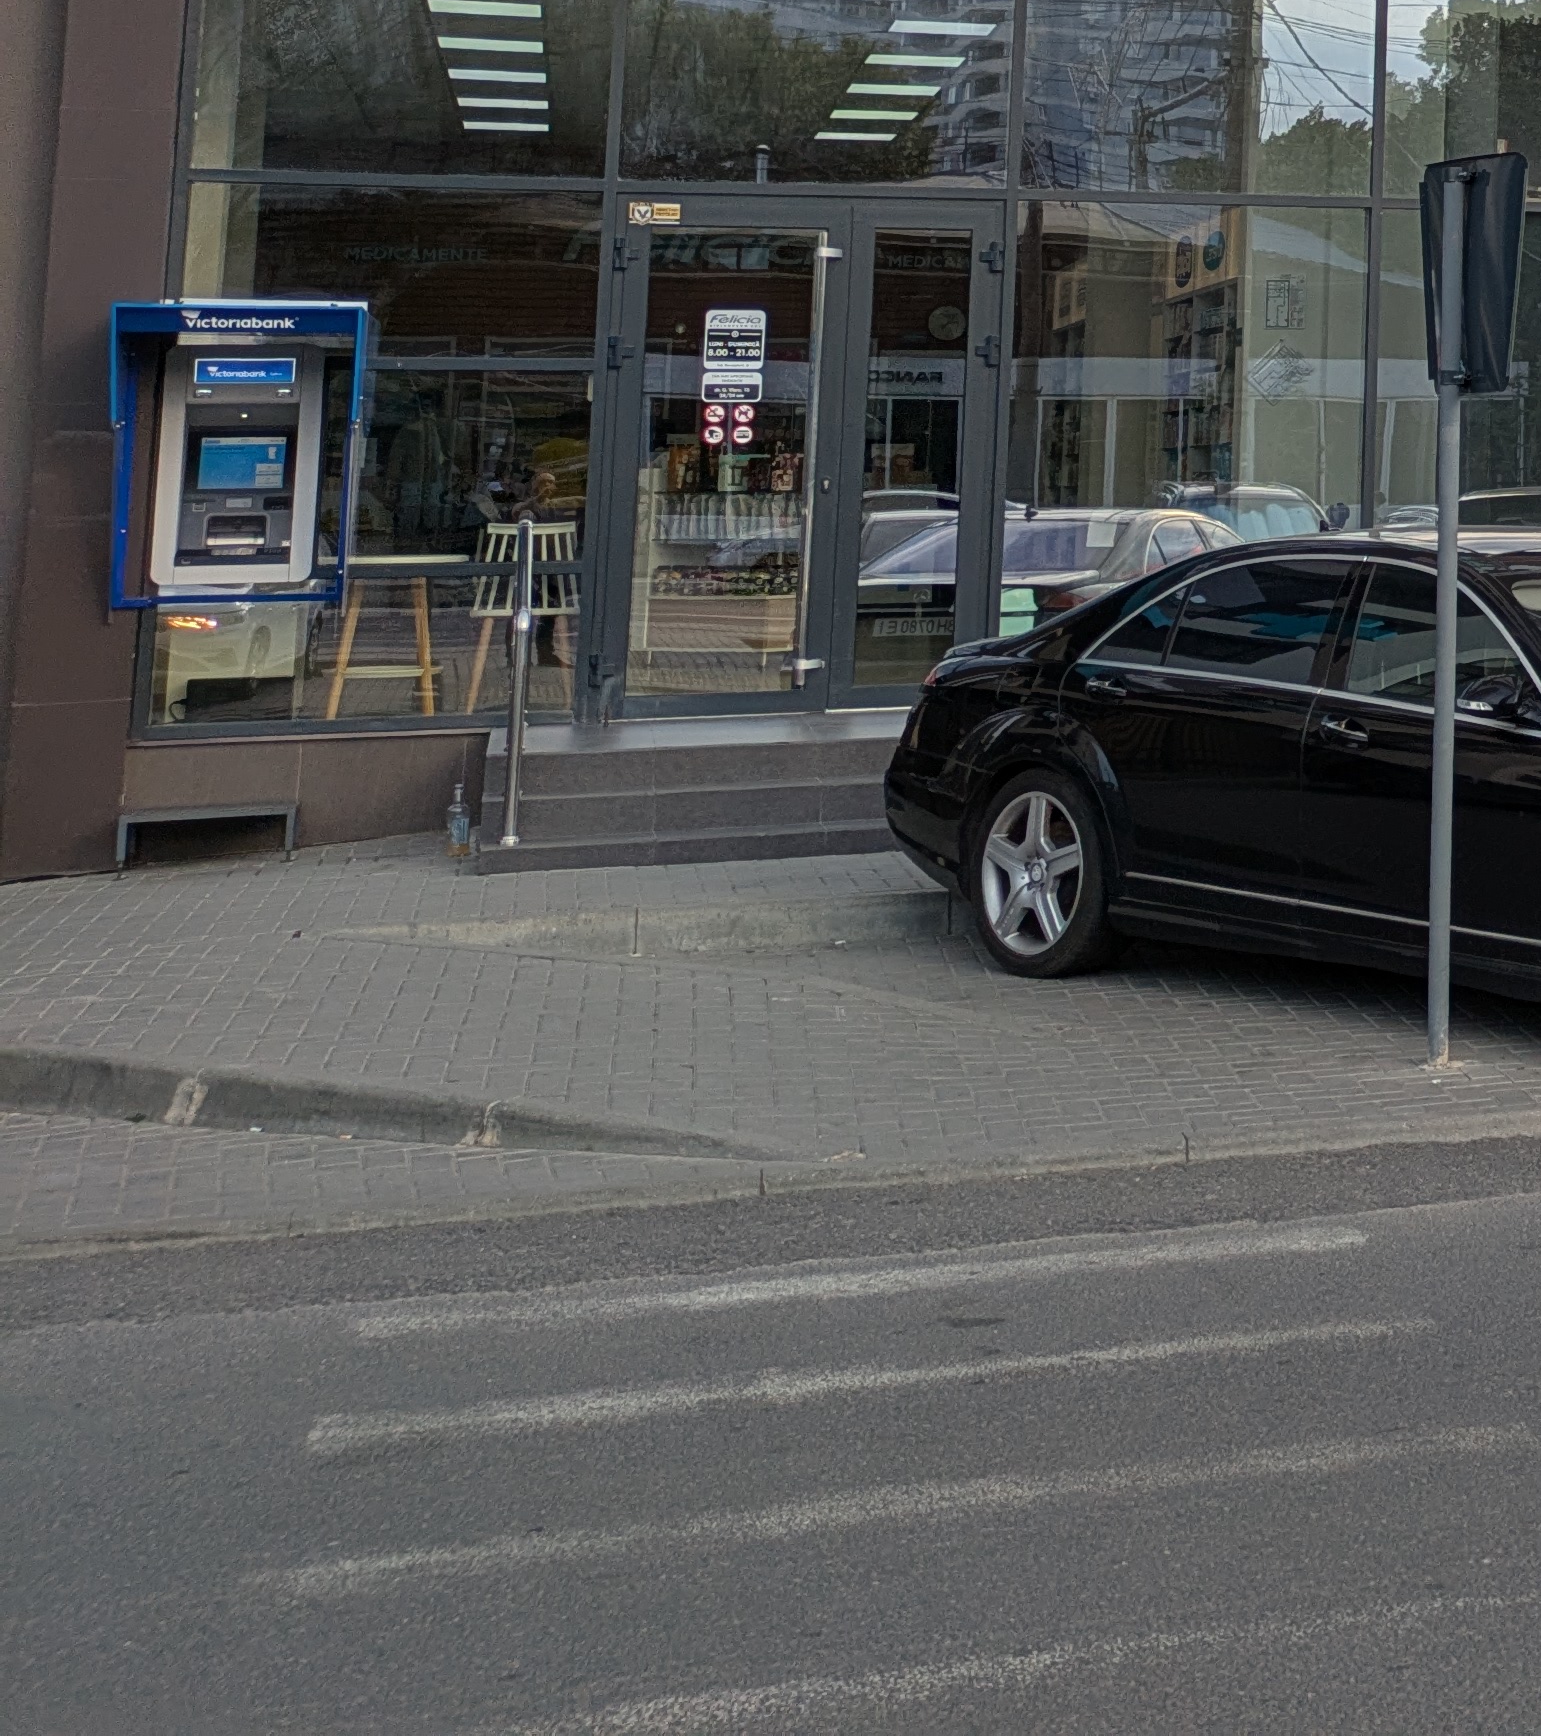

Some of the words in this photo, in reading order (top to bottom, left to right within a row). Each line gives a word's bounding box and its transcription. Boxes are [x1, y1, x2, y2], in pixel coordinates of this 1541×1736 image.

[710, 314, 761, 324] Felicia
[708, 349, 728, 357] 8.00
[735, 349, 760, 357] 21.00
